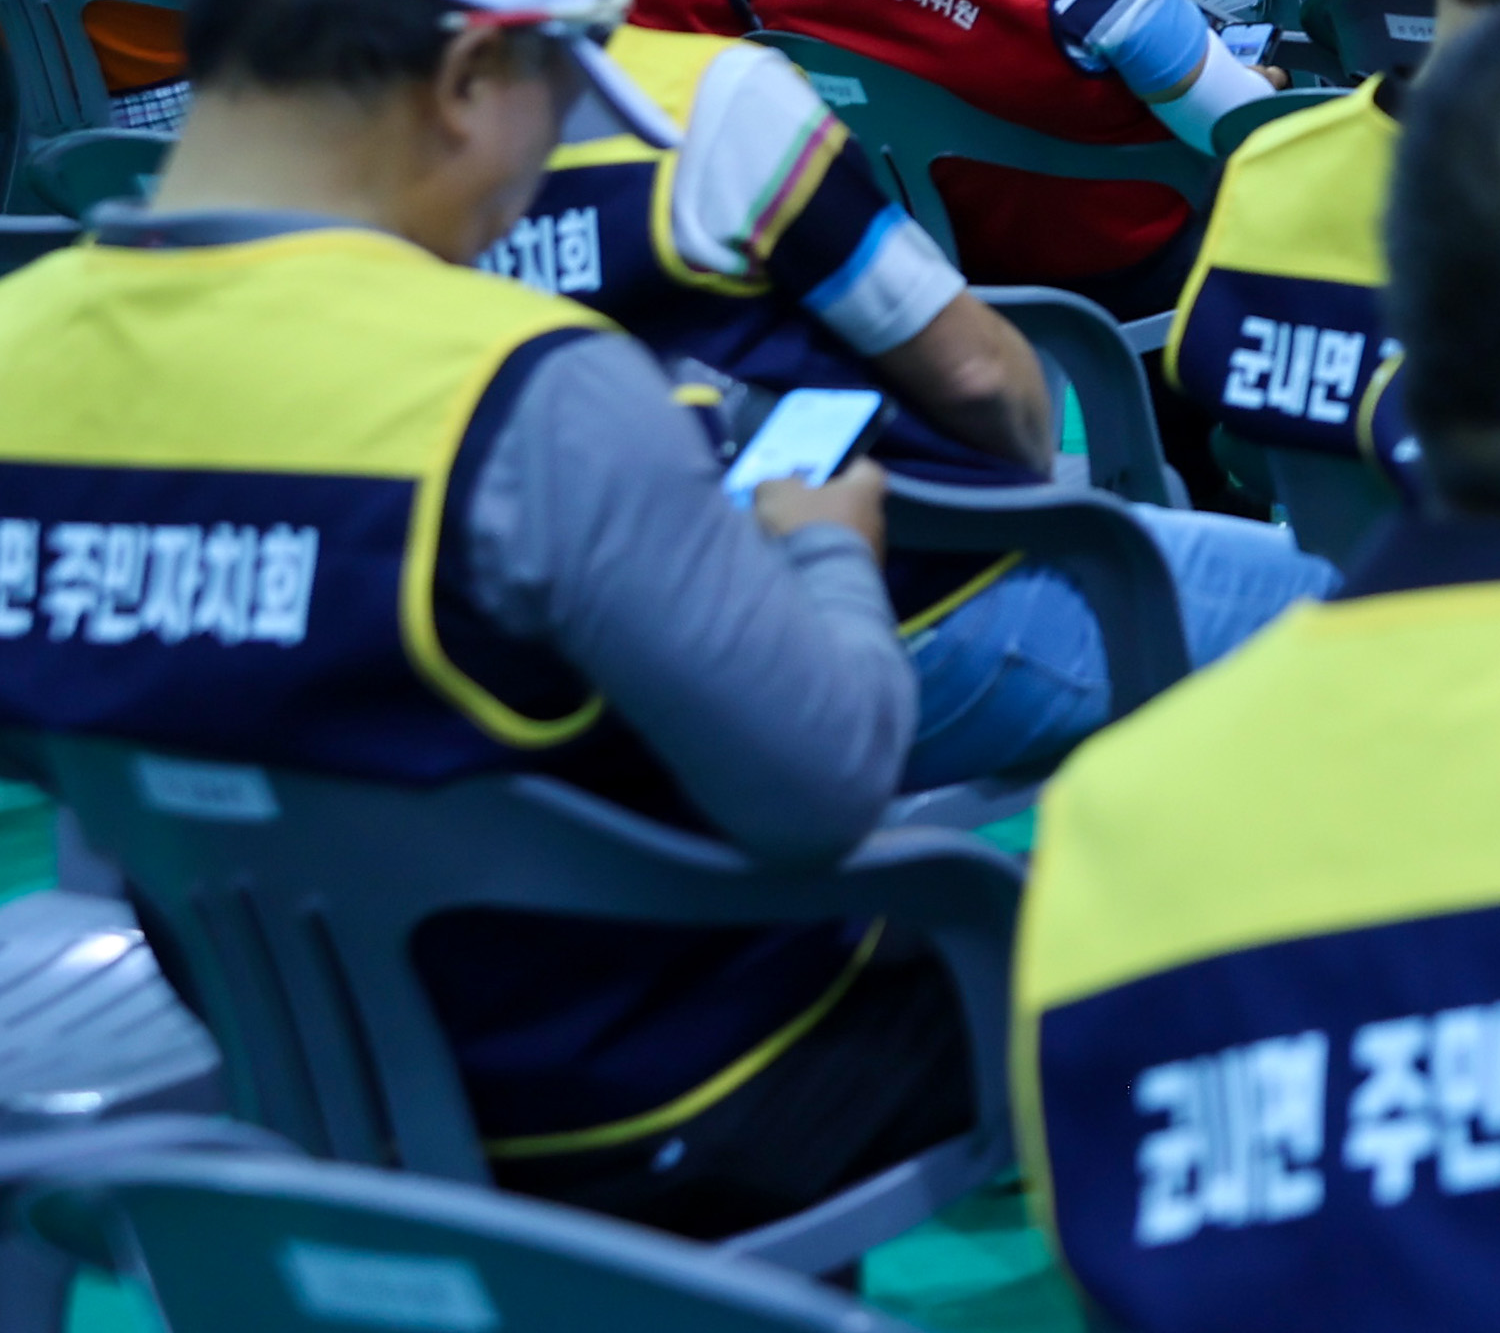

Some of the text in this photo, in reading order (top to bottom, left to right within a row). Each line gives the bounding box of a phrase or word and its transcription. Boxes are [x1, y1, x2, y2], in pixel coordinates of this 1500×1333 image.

[1221, 314, 1368, 425] 군내면
[38, 519, 321, 649] 주민자치회
[1132, 1028, 1332, 1248] 군내면
